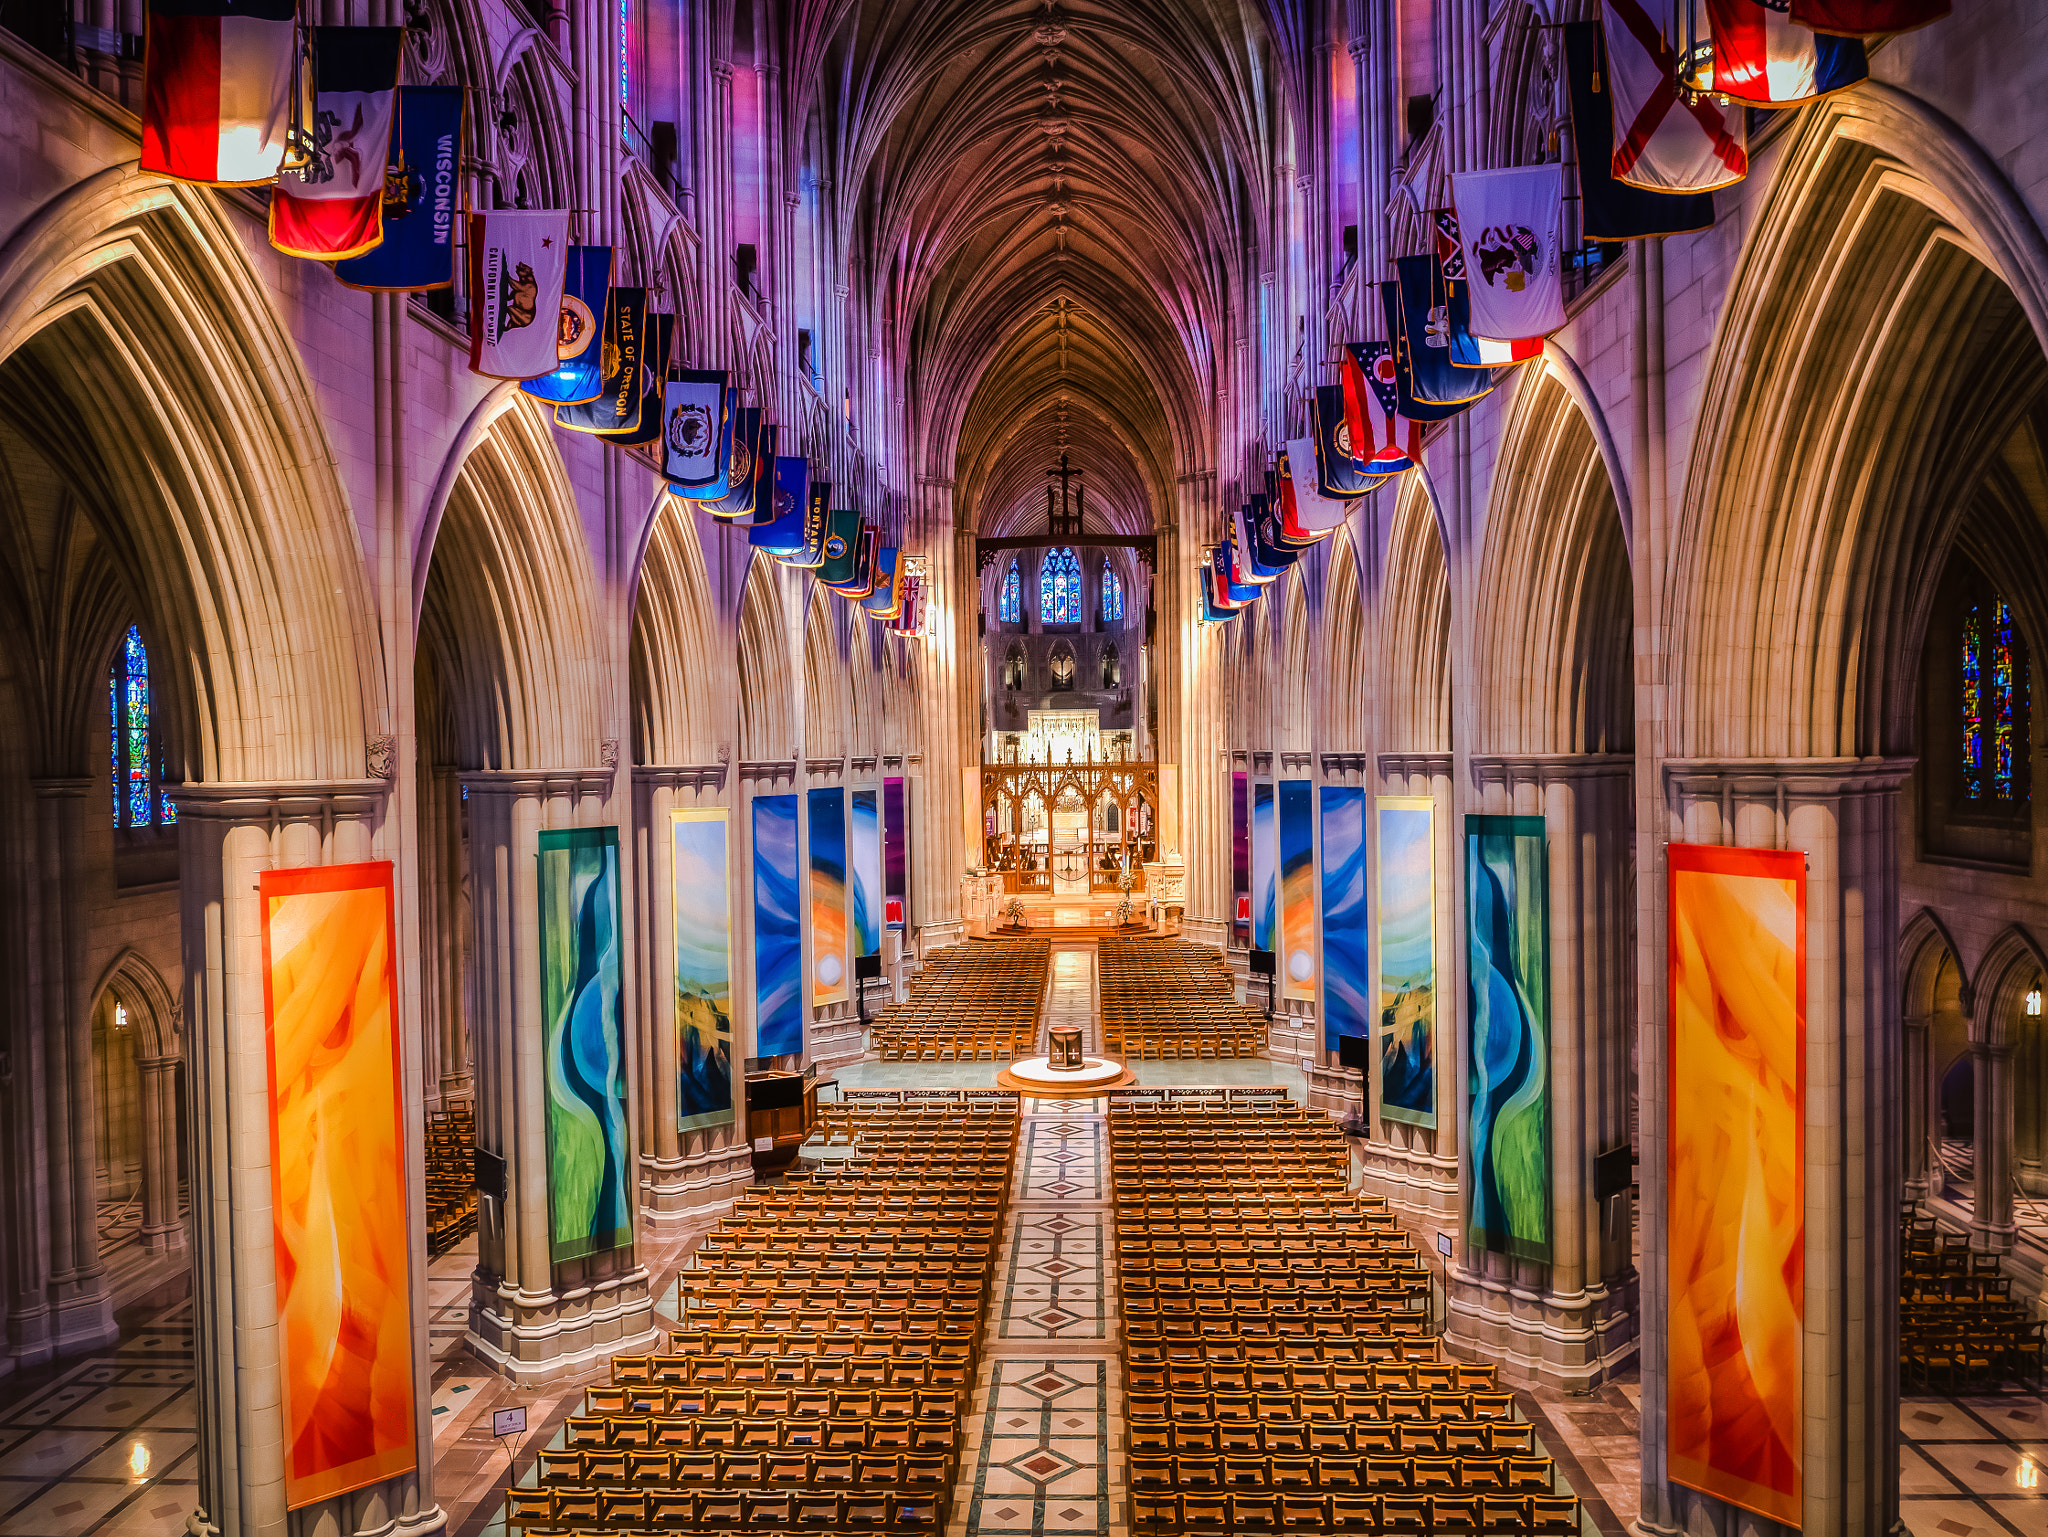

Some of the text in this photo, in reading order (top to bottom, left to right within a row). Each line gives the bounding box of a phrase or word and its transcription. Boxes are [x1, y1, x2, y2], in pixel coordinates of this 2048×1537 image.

[433, 134, 452, 244] WISCONSIN
[487, 247, 498, 347] CALIFORNIA REPUBLIC
[616, 306, 634, 416] STATE OF OREGON
[810, 497, 821, 553] MONTANA
[506, 1411, 513, 1422] 4
